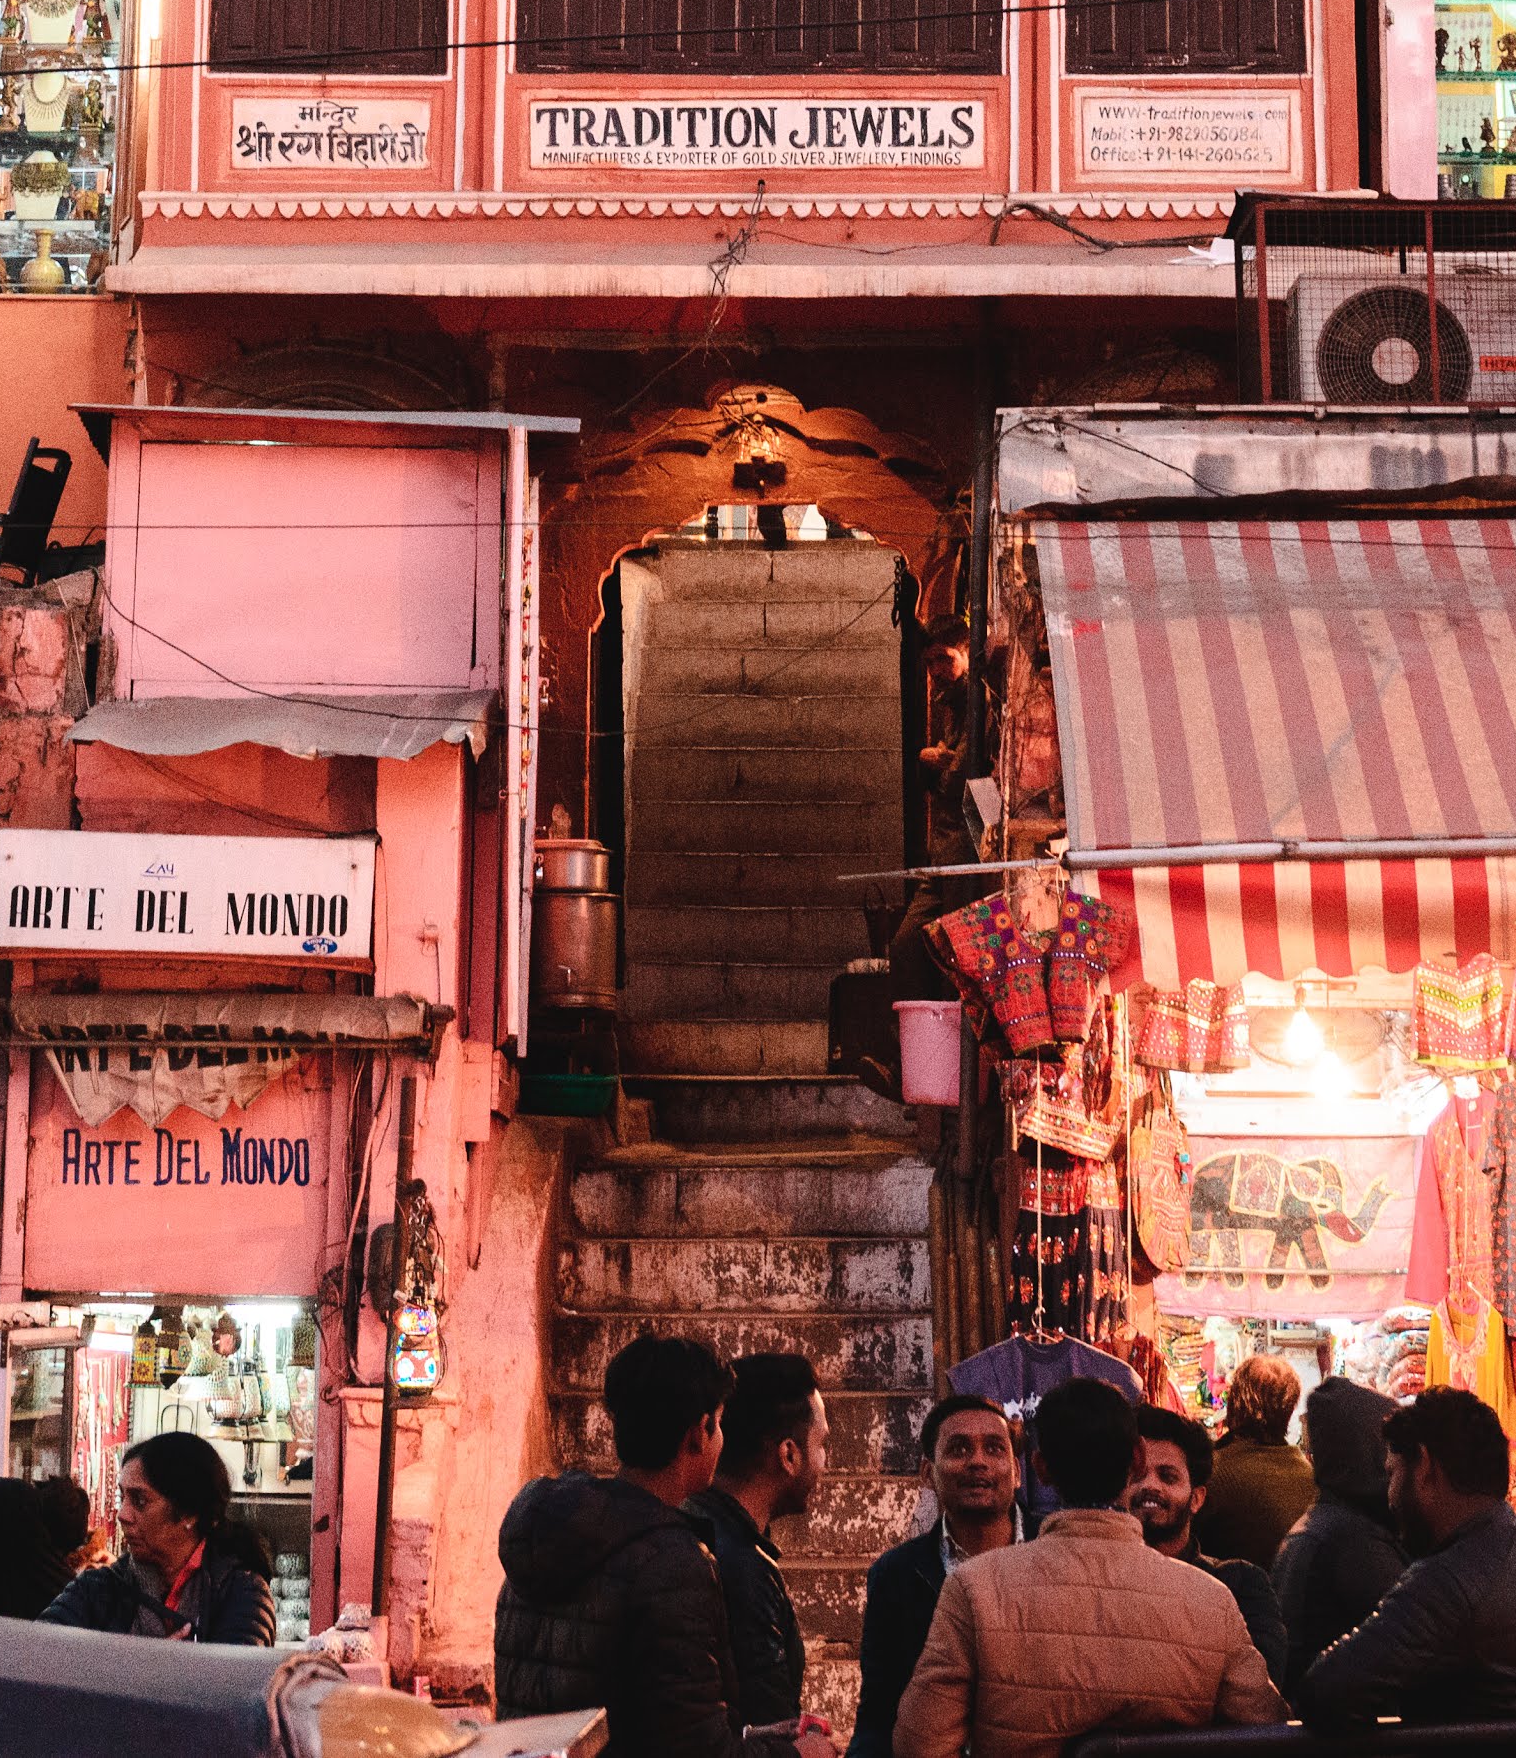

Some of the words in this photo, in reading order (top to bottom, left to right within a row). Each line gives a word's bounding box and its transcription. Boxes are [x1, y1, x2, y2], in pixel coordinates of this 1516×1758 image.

[536, 107, 779, 148] TRADITION
[789, 106, 975, 149] JEWELS
[543, 151, 641, 165] MANUFACTURERS
[657, 151, 717, 165] EXPORTER
[721, 152, 735, 165] OF
[743, 152, 776, 165] GOLD
[781, 152, 825, 165] SILVER
[901, 152, 960, 166] FINDINGS
[9, 885, 105, 931] ARTE
[135, 890, 193, 934] DEL
[225, 892, 348, 937] MONDO
